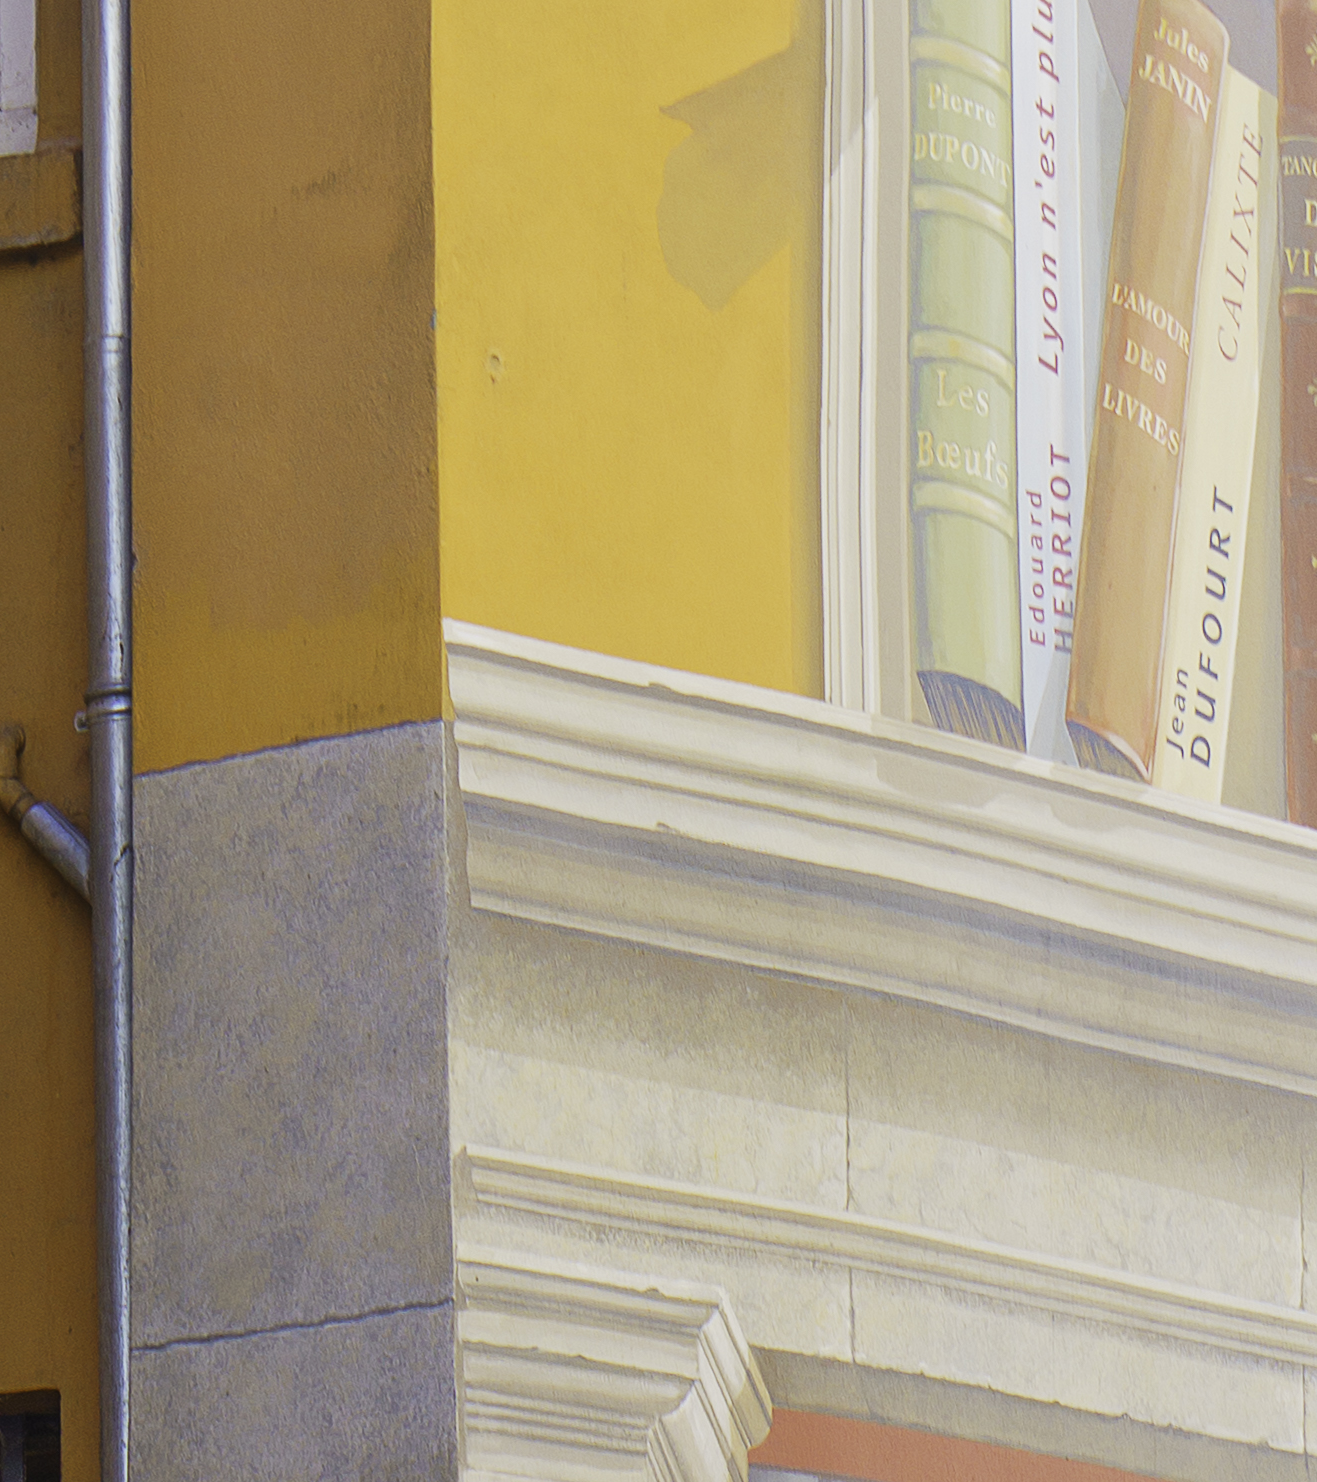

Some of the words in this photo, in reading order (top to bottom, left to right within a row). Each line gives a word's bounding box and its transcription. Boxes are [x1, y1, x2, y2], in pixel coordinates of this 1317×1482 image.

[1153, 18, 1209, 74] Jules
[928, 82, 996, 127] Pierre
[1138, 54, 1212, 123] JANIN
[914, 133, 1010, 188] DUPONT
[1034, 97, 1058, 231] n'est
[1217, 123, 1263, 363] CALIXTE
[1038, 252, 1064, 377] Lyon
[1113, 283, 1191, 357] L'AMOUR
[936, 370, 989, 417] Les
[1124, 339, 1166, 385] DES
[1102, 382, 1180, 457] LIVRES
[1026, 489, 1046, 647] Edouard
[1049, 444, 1073, 655] HERRIOT
[1190, 485, 1234, 769] DUFOURT
[1166, 668, 1188, 759] Jean
